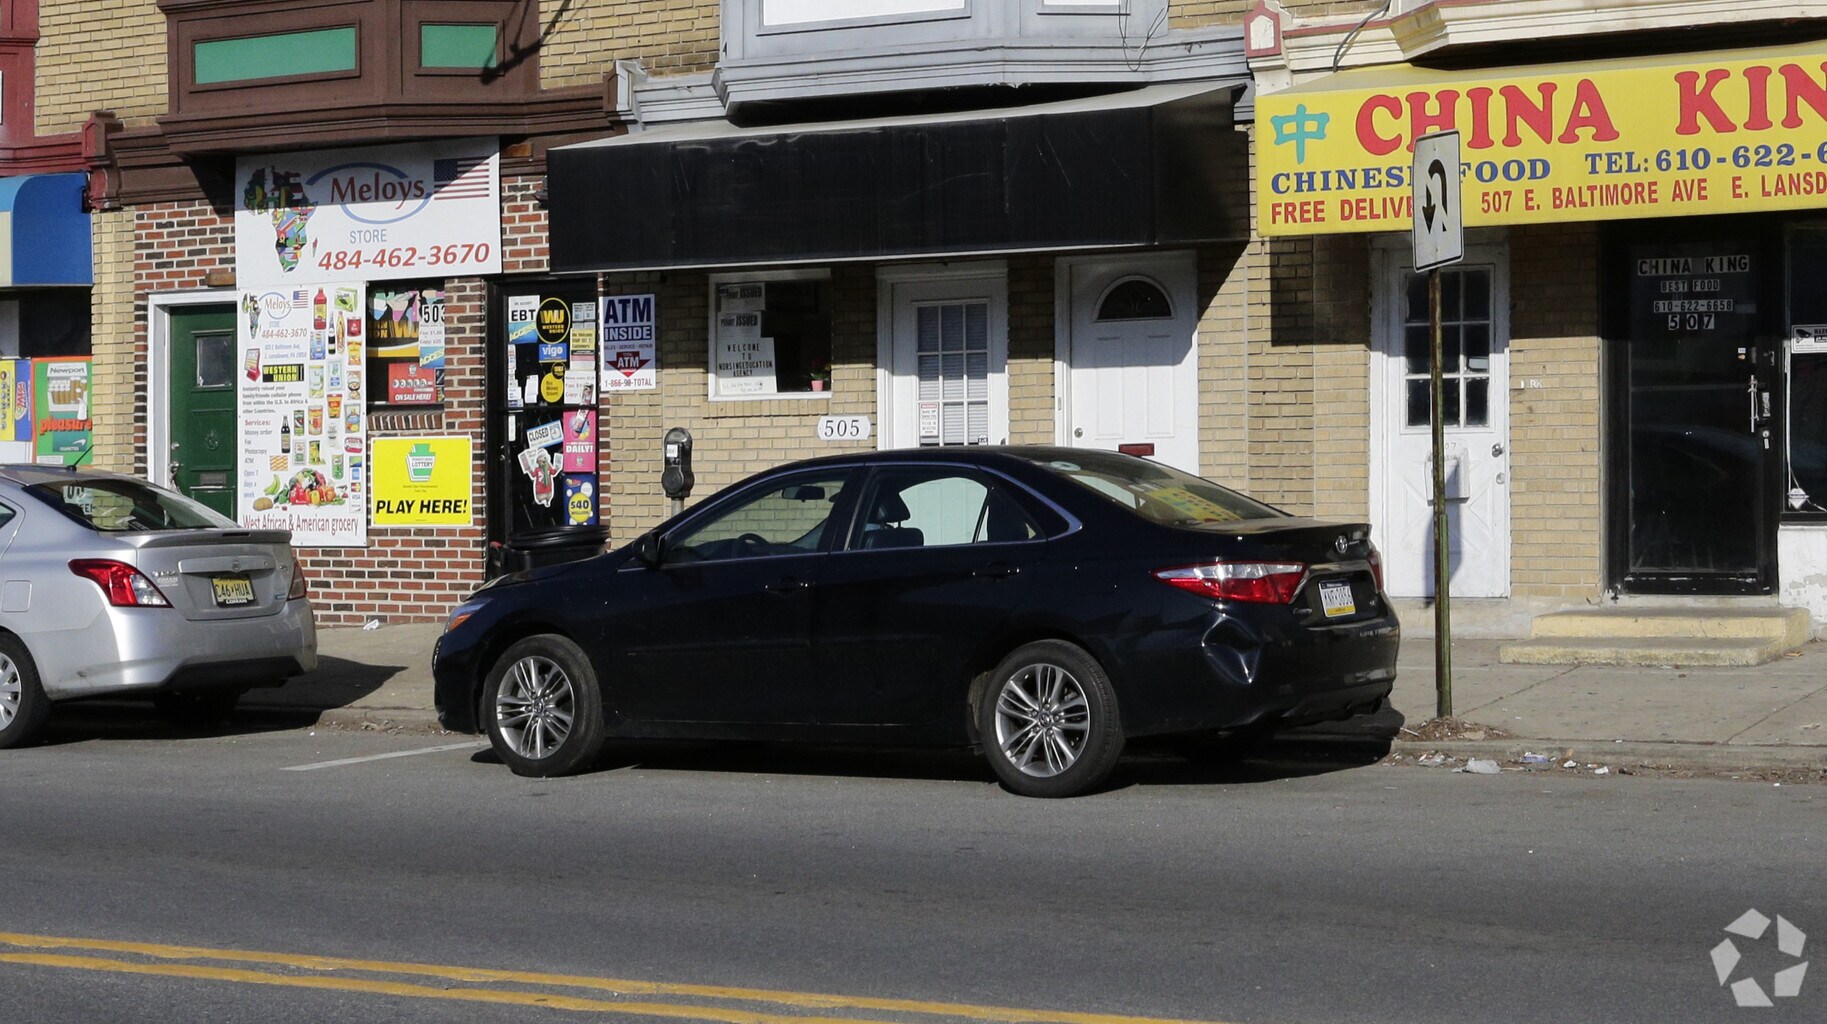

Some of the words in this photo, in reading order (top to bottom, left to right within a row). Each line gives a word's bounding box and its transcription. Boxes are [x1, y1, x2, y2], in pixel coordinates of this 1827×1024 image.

[1355, 79, 1620, 156] CHINA
[1271, 165, 1413, 194] CHINES
[330, 171, 425, 210] Meloys
[1271, 200, 1326, 225] FREE
[1340, 196, 1413, 221] DELIVE
[1481, 190, 1513, 214] 507
[1524, 189, 1541, 211] E.
[1552, 181, 1658, 209] BALTIMORE
[1671, 178, 1708, 202] AVE
[1732, 176, 1749, 198] E.
[350, 229, 387, 244] STORE
[318, 243, 490, 270] 484-462-3670
[1639, 259, 1692, 275] CHINA
[1705, 256, 1748, 273] KING
[1661, 281, 1687, 292] BEST
[1693, 280, 1719, 291] FOOD
[264, 297, 291, 313] Meloys
[604, 298, 651, 324] ATM
[1654, 300, 1732, 312] 610-622-6658
[511, 309, 536, 321] EBT
[540, 310, 565, 324] WU
[736, 314, 758, 327] ISSUED
[261, 328, 307, 339] 484-462-3670
[604, 326, 651, 341] INSIDE
[542, 345, 563, 356] vigo
[727, 343, 760, 352] WELCOME
[617, 357, 639, 368] ATM
[263, 366, 297, 375] WESTERN
[274, 374, 297, 382] UNION
[40, 416, 92, 435] pleasure
[824, 419, 860, 437] 505
[528, 427, 549, 442] CLOSED
[566, 445, 593, 453] DAILY!
[376, 500, 415, 514] PLAY
[419, 499, 467, 514] HERE!
[571, 500, 589, 509] $40
[243, 515, 260, 529] West
[262, 514, 287, 530] African
[288, 514, 294, 531] &
[296, 514, 330, 532] American
[331, 517, 359, 536] grocery
